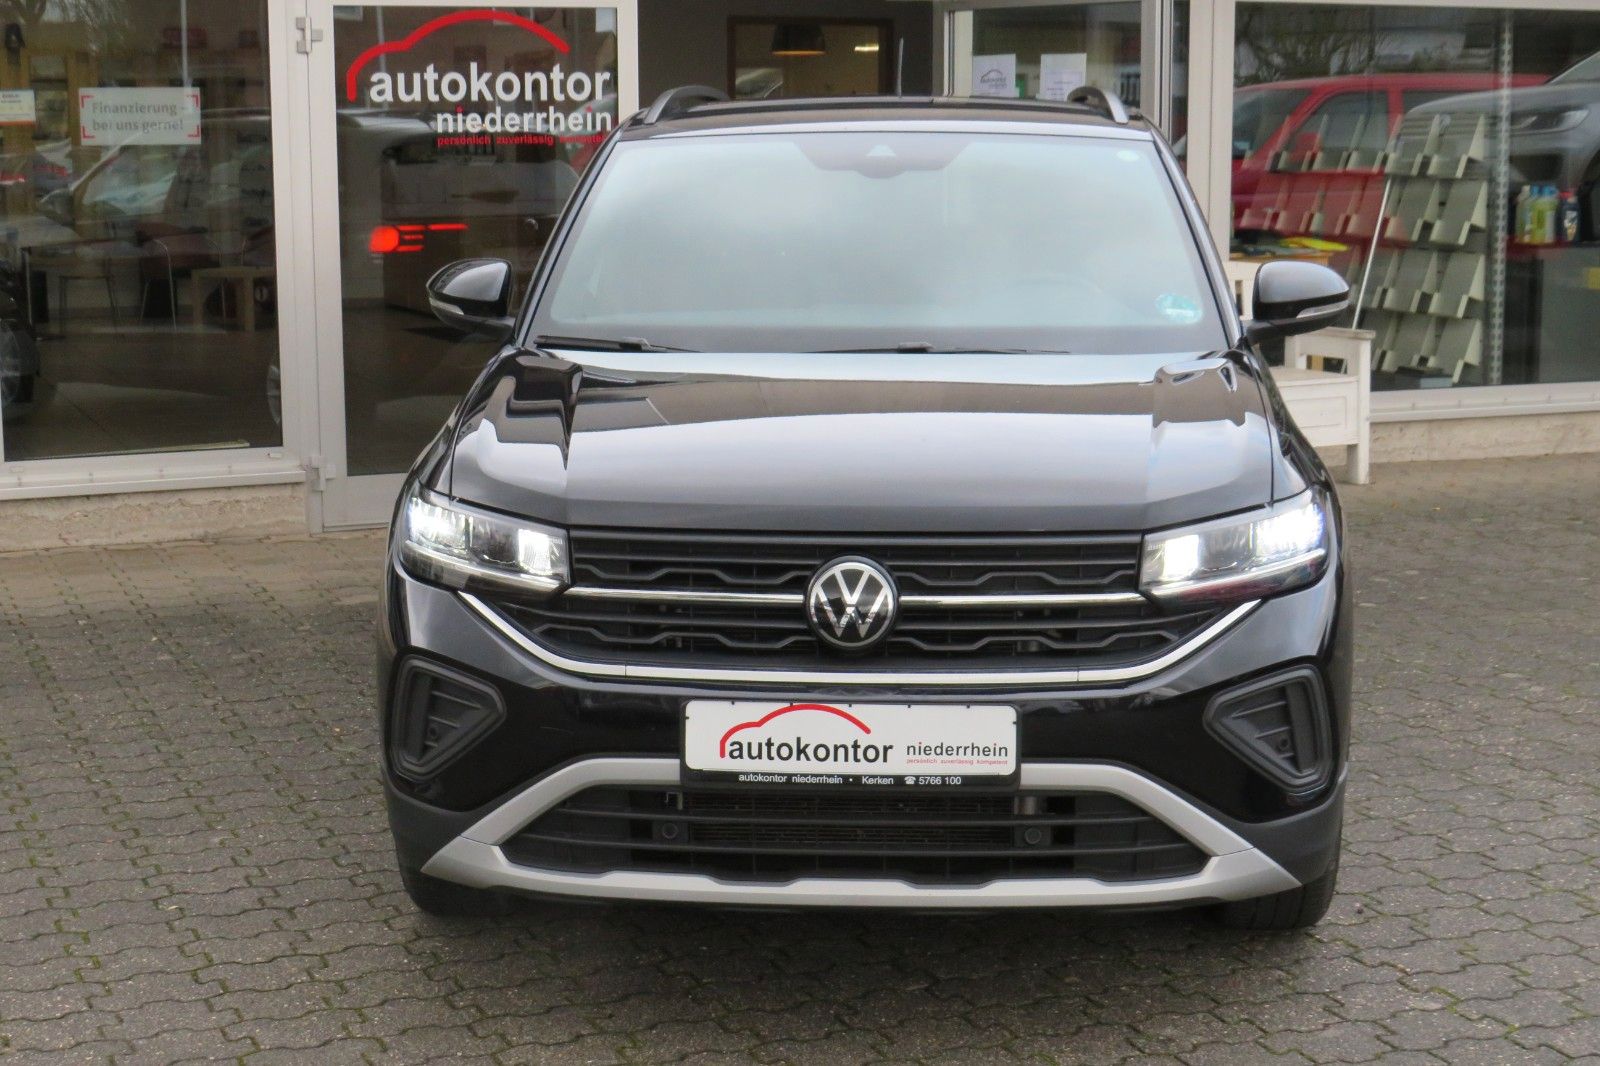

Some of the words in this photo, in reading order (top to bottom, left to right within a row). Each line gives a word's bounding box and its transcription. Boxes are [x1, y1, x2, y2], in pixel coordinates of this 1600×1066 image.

[370, 61, 611, 102] autokontor
[92, 102, 177, 116] Finanzierung
[92, 118, 113, 131] bei
[116, 120, 138, 131] uns
[436, 104, 612, 133] niederrhein
[437, 134, 491, 147] persönlich
[728, 736, 894, 763] autokontor
[906, 741, 1008, 758] niederrhein
[906, 757, 938, 766] persönlich
[940, 758, 974, 767] zuverlässig
[976, 758, 1008, 767] kompetent
[738, 773, 788, 783] autokontor
[791, 774, 843, 784] niederrhein
[861, 775, 894, 785] Kerken
[918, 776, 942, 785] 5766
[944, 776, 962, 785] 100
